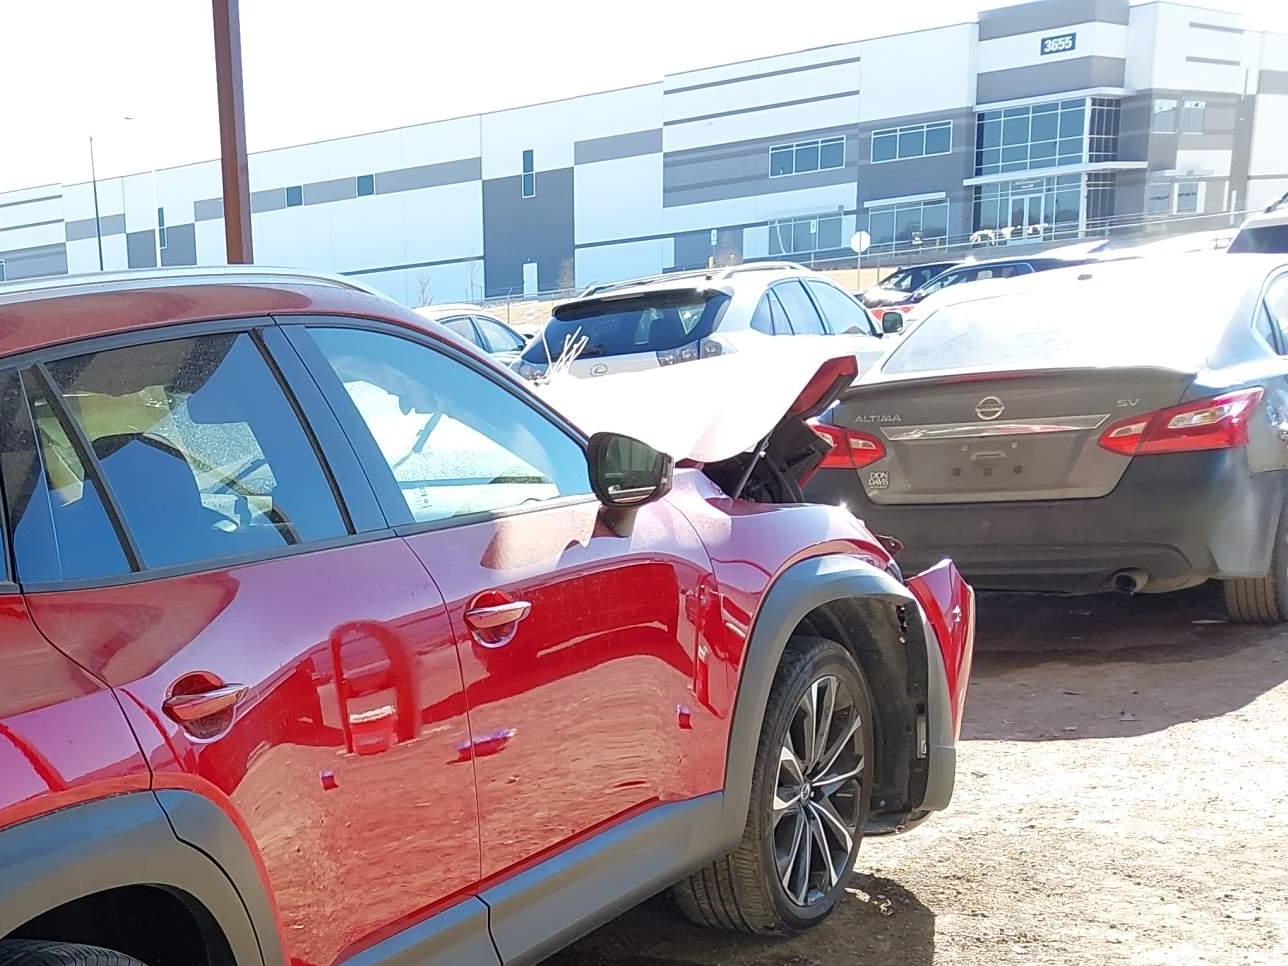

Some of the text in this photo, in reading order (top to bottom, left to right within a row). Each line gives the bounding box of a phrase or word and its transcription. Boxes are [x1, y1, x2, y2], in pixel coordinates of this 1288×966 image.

[1043, 35, 1074, 53] 3655
[1117, 398, 1141, 408] SV
[854, 414, 902, 424] ALTIMA
[870, 471, 889, 480] DON
